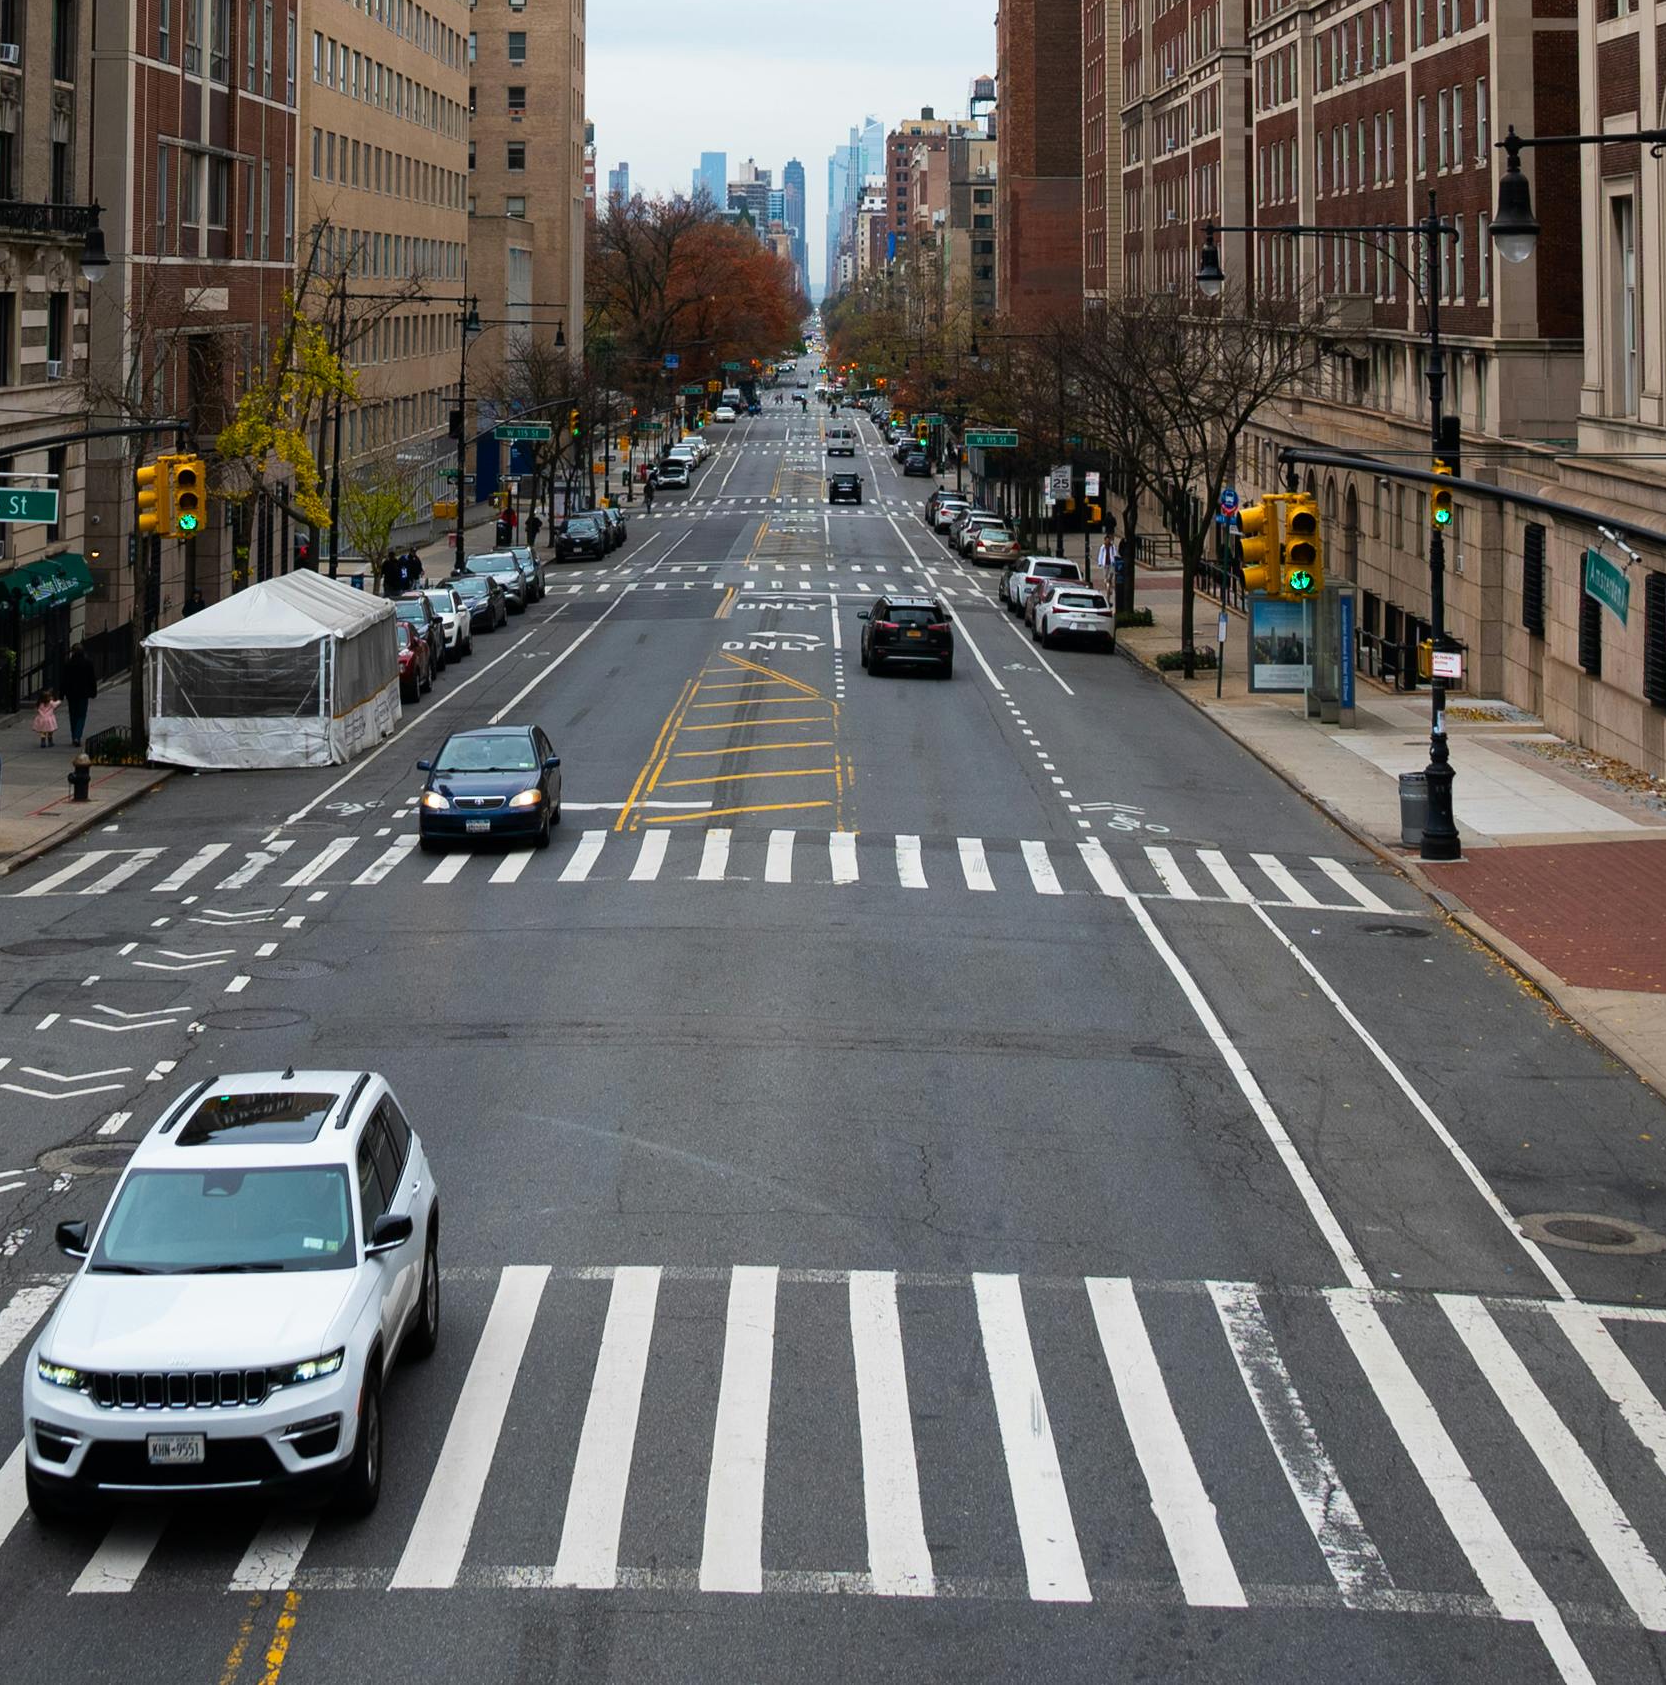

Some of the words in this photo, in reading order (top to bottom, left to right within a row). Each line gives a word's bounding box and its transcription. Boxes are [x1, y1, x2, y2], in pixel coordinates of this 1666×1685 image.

[1053, 478, 1069, 488] 25
[9, 495, 27, 515] St
[737, 603, 826, 611] ONLY
[722, 641, 827, 651] ONLY
